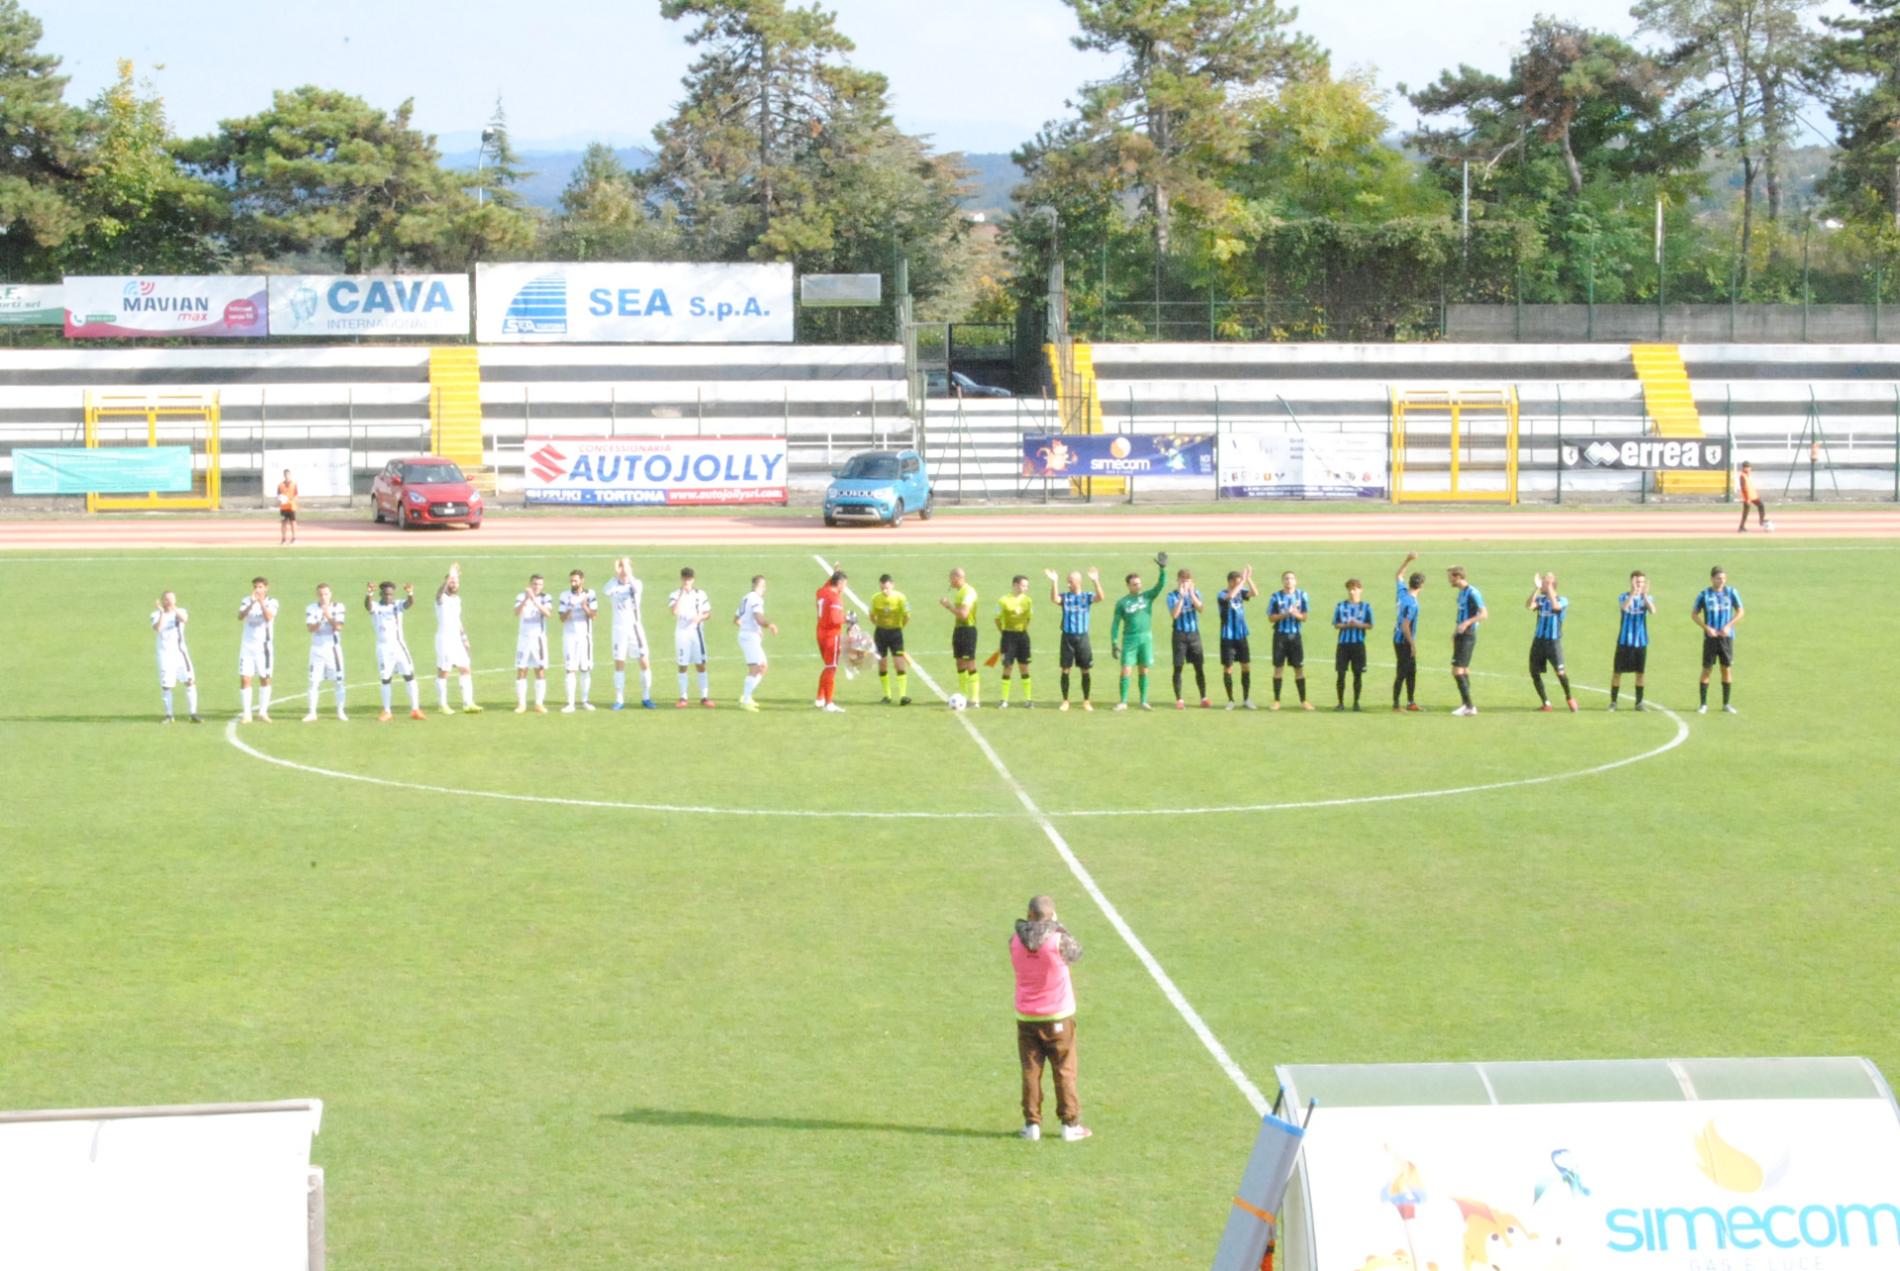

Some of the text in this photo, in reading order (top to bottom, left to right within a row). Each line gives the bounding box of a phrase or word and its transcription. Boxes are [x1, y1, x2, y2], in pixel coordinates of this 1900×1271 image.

[123, 297, 208, 312] MAVIAN
[327, 280, 454, 314] CAVA
[588, 288, 771, 321] SEA S.p.A.
[177, 313, 208, 321] max
[568, 454, 784, 482] AUTOJOLLY
[1089, 458, 1151, 471] simecom
[593, 490, 666, 502] TORTONA
[817, 597, 824, 618] 1
[1605, 1202, 1900, 1252] simecom
